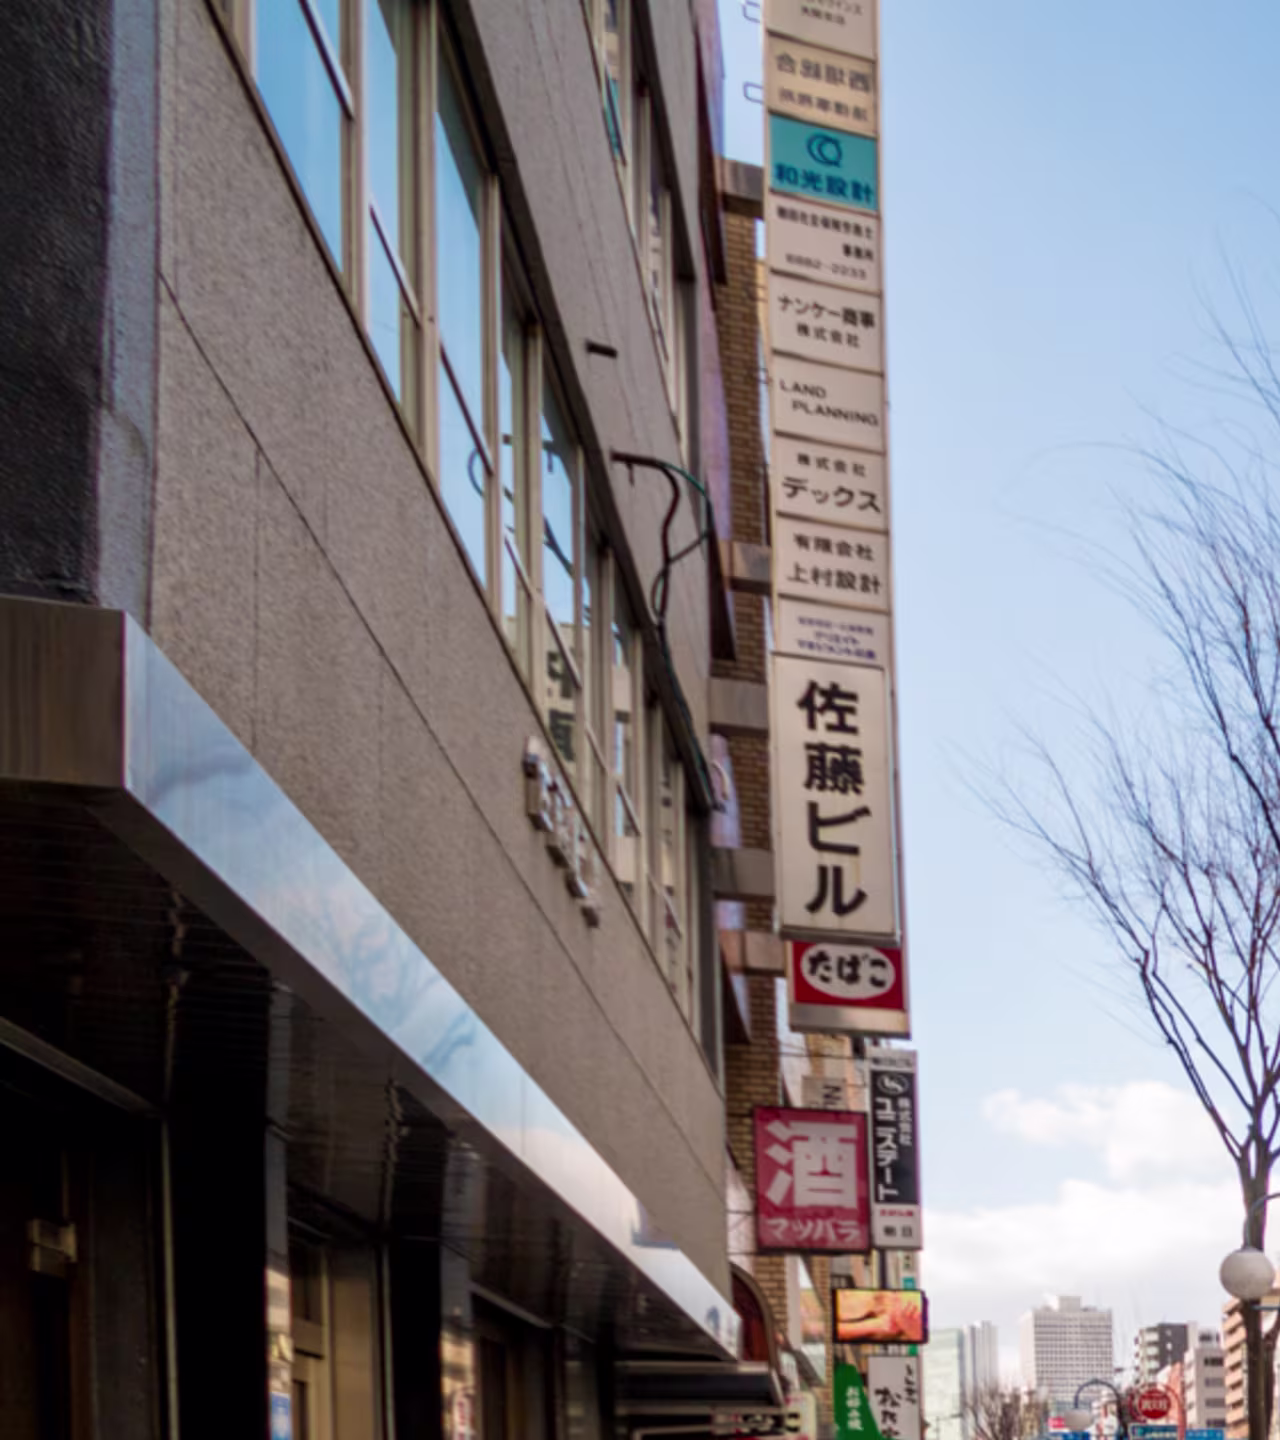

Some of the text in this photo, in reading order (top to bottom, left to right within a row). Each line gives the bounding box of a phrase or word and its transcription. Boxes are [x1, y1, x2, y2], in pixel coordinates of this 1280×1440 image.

[775, 162, 874, 204] 和光設計
[796, 322, 860, 348] 株式会社
[779, 379, 827, 400] LAND
[791, 400, 880, 427] PLANNING
[796, 452, 867, 478] 株式会社
[793, 533, 875, 562] 有限会社
[786, 562, 882, 595] 上村設計
[796, 679, 872, 917] 佐藤ビル
[807, 948, 889, 989] たばこ
[766, 1119, 858, 1209] 酒
